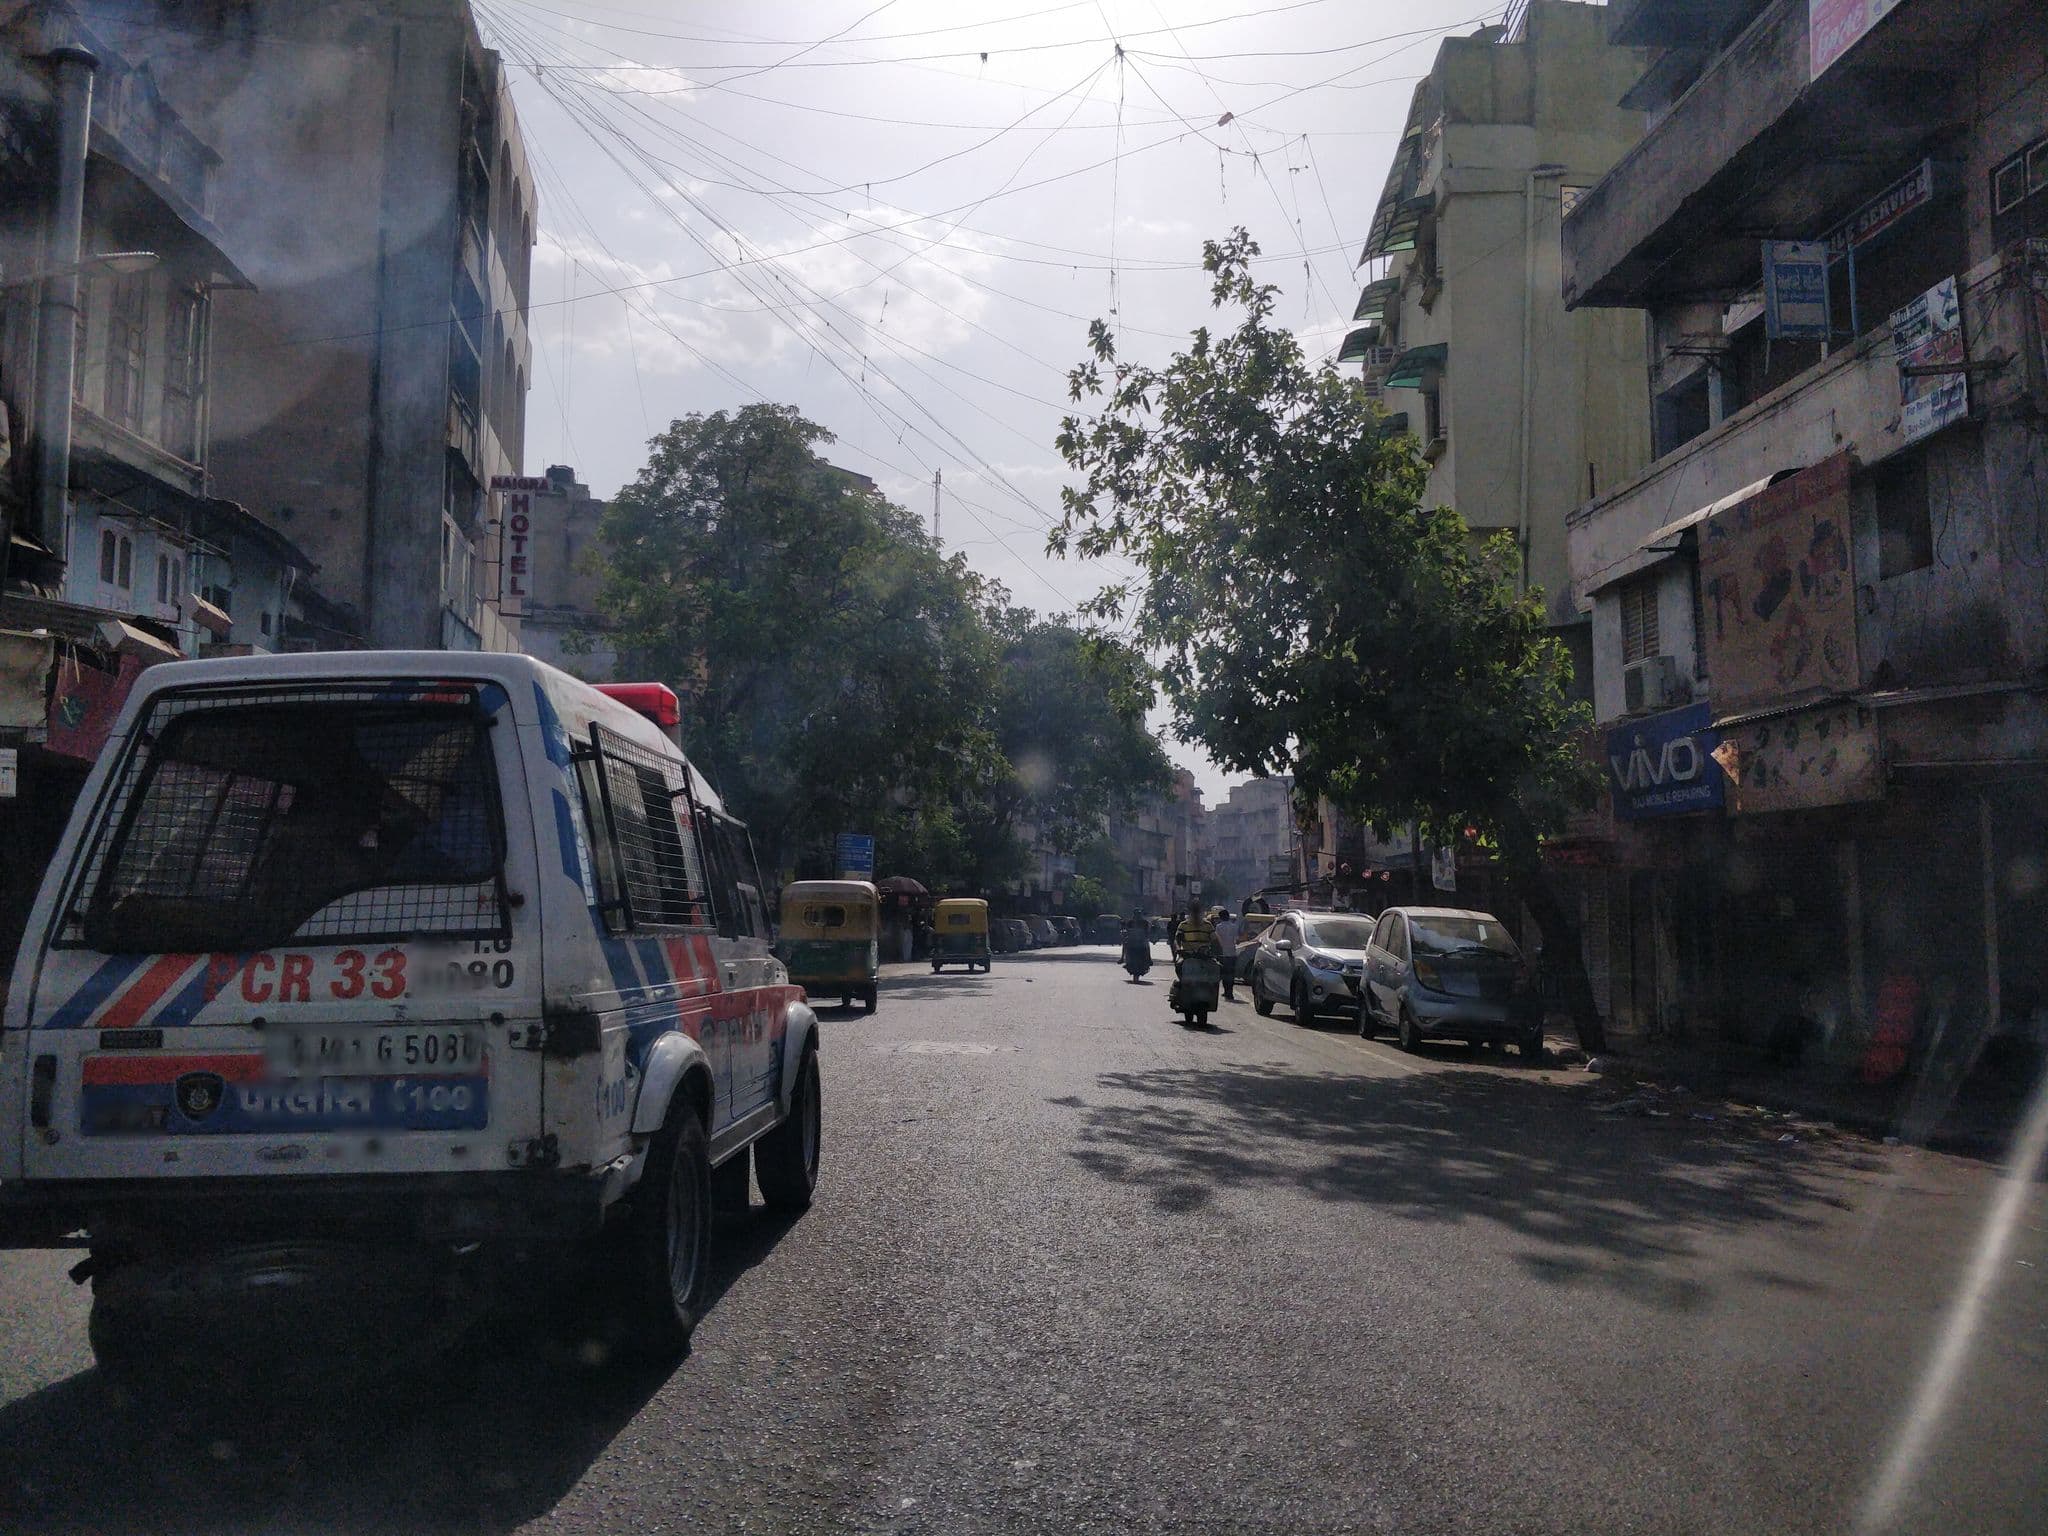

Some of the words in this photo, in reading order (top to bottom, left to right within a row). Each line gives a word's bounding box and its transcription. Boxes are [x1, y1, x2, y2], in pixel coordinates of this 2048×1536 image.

[510, 494, 530, 596] HOTEL
[202, 951, 315, 1004] PCR
[331, 948, 409, 1000] 33
